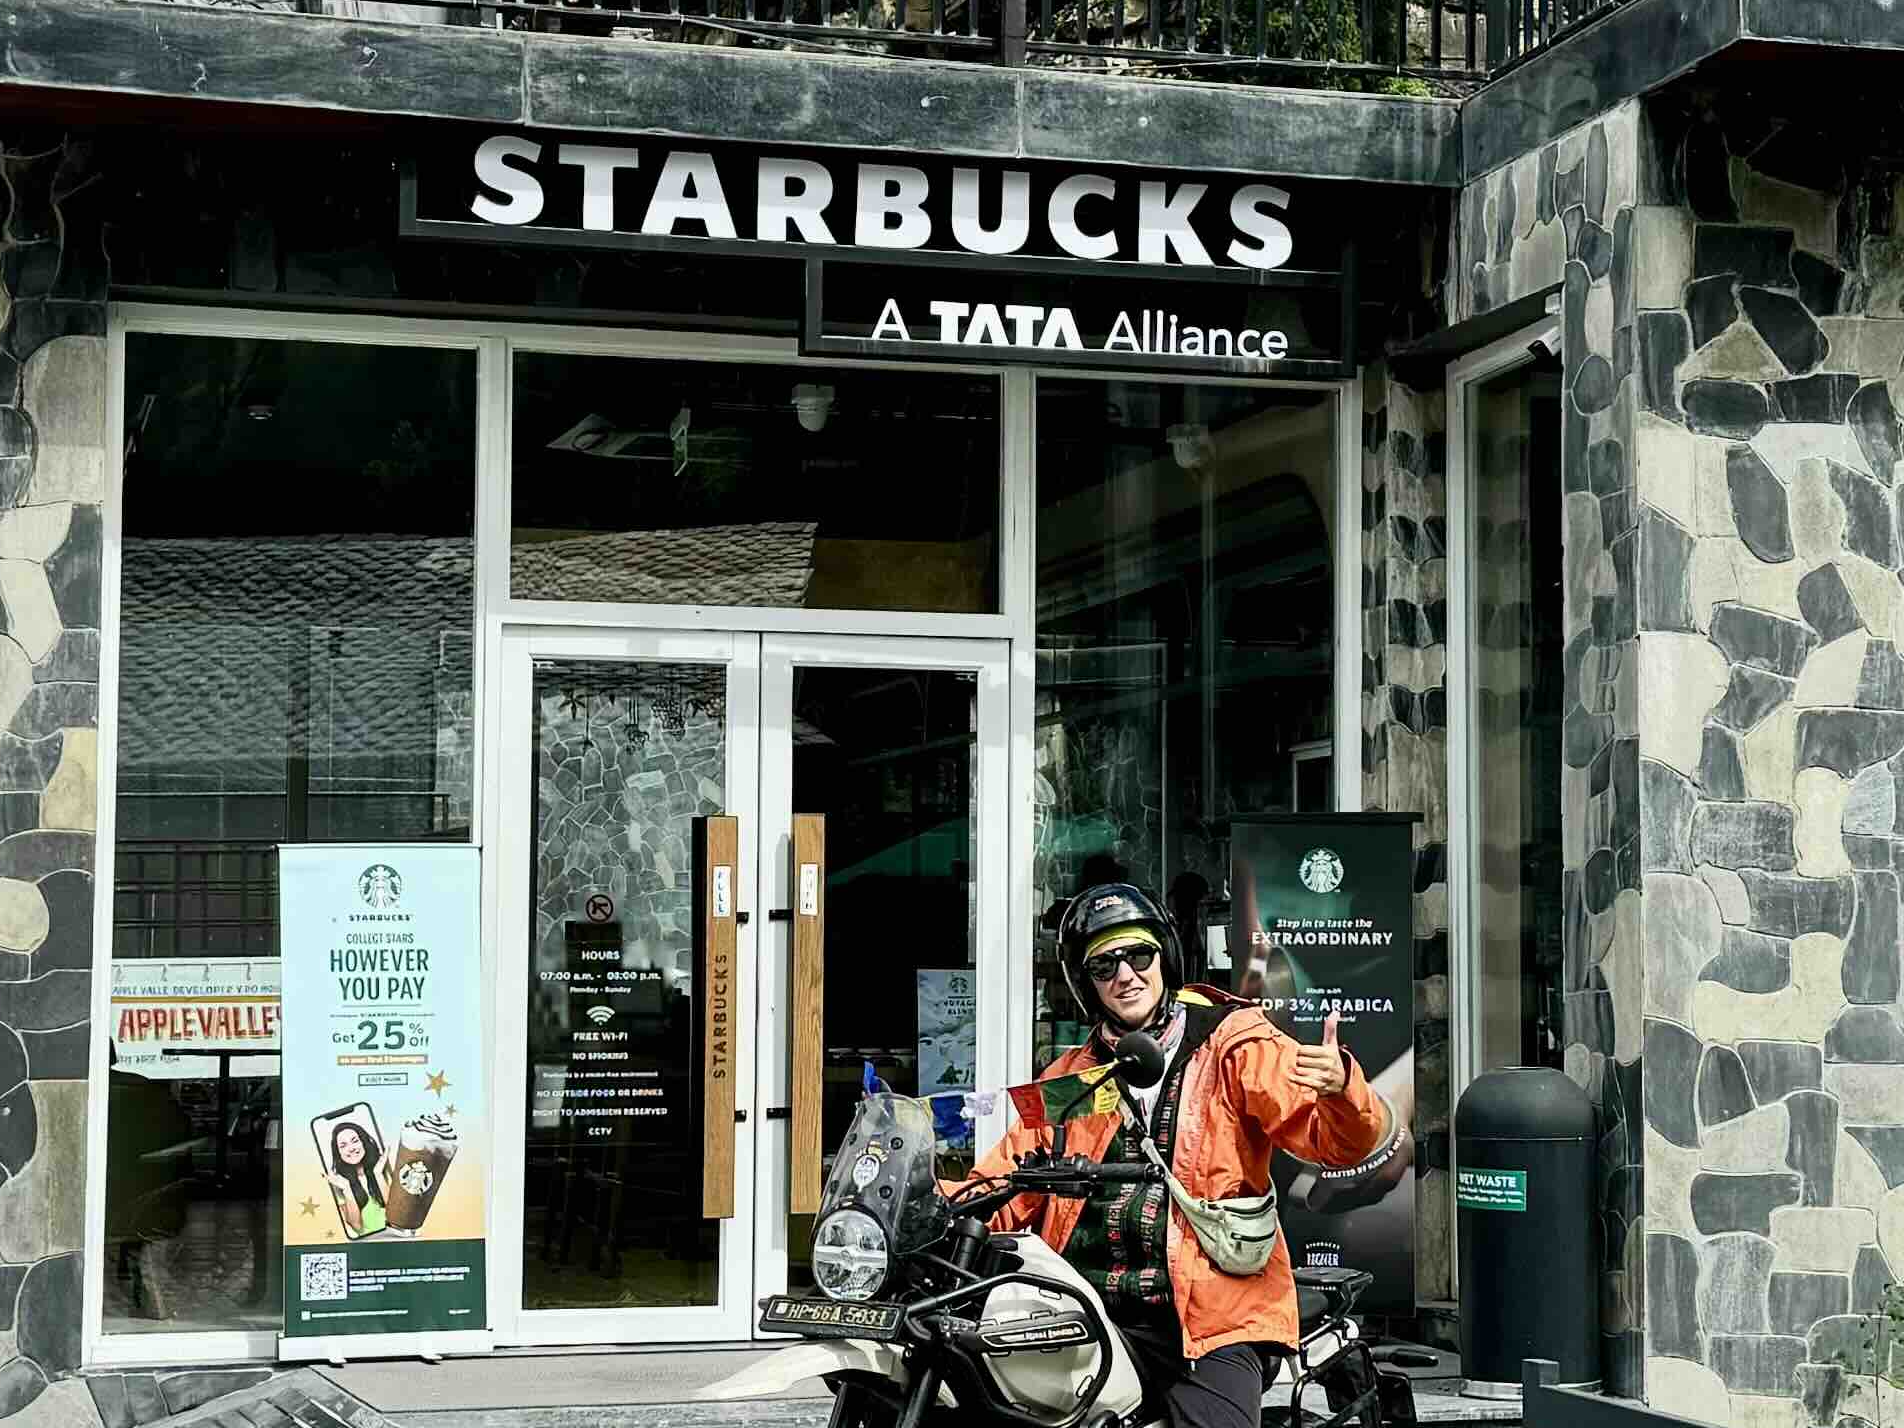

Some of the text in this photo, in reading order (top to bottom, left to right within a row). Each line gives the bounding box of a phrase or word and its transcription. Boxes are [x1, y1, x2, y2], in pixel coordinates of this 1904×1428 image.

[471, 135, 1293, 269] STARBUCKS
[871, 297, 1288, 359] A TATA Alliance
[348, 913, 411, 922] STARBUCKS
[1314, 918, 1325, 928] to
[1327, 918, 1353, 928] taste
[345, 932, 415, 944] COLLECT STARS
[1251, 931, 1393, 946] EXTRAORDINARY
[330, 948, 429, 972] HOWEVER
[581, 950, 621, 961] HOURS
[539, 971, 572, 981] 07:00
[338, 976, 425, 1000] YOU PAY
[1288, 998, 1315, 1012] 3%
[1319, 998, 1395, 1013] ARABICA
[713, 954, 728, 1079] STARBUCKS
[118, 1006, 281, 1043] APPLEVALLE
[332, 1032, 356, 1044] Get
[357, 1020, 406, 1050] 25
[409, 1035, 430, 1047] Off
[572, 1032, 599, 1042] FREE
[572, 1052, 586, 1061] NO
[536, 1090, 550, 1098] NO
[560, 1108, 573, 1117] TO
[588, 1127, 613, 1137] CCTV
[1475, 1174, 1517, 1188] WASTE
